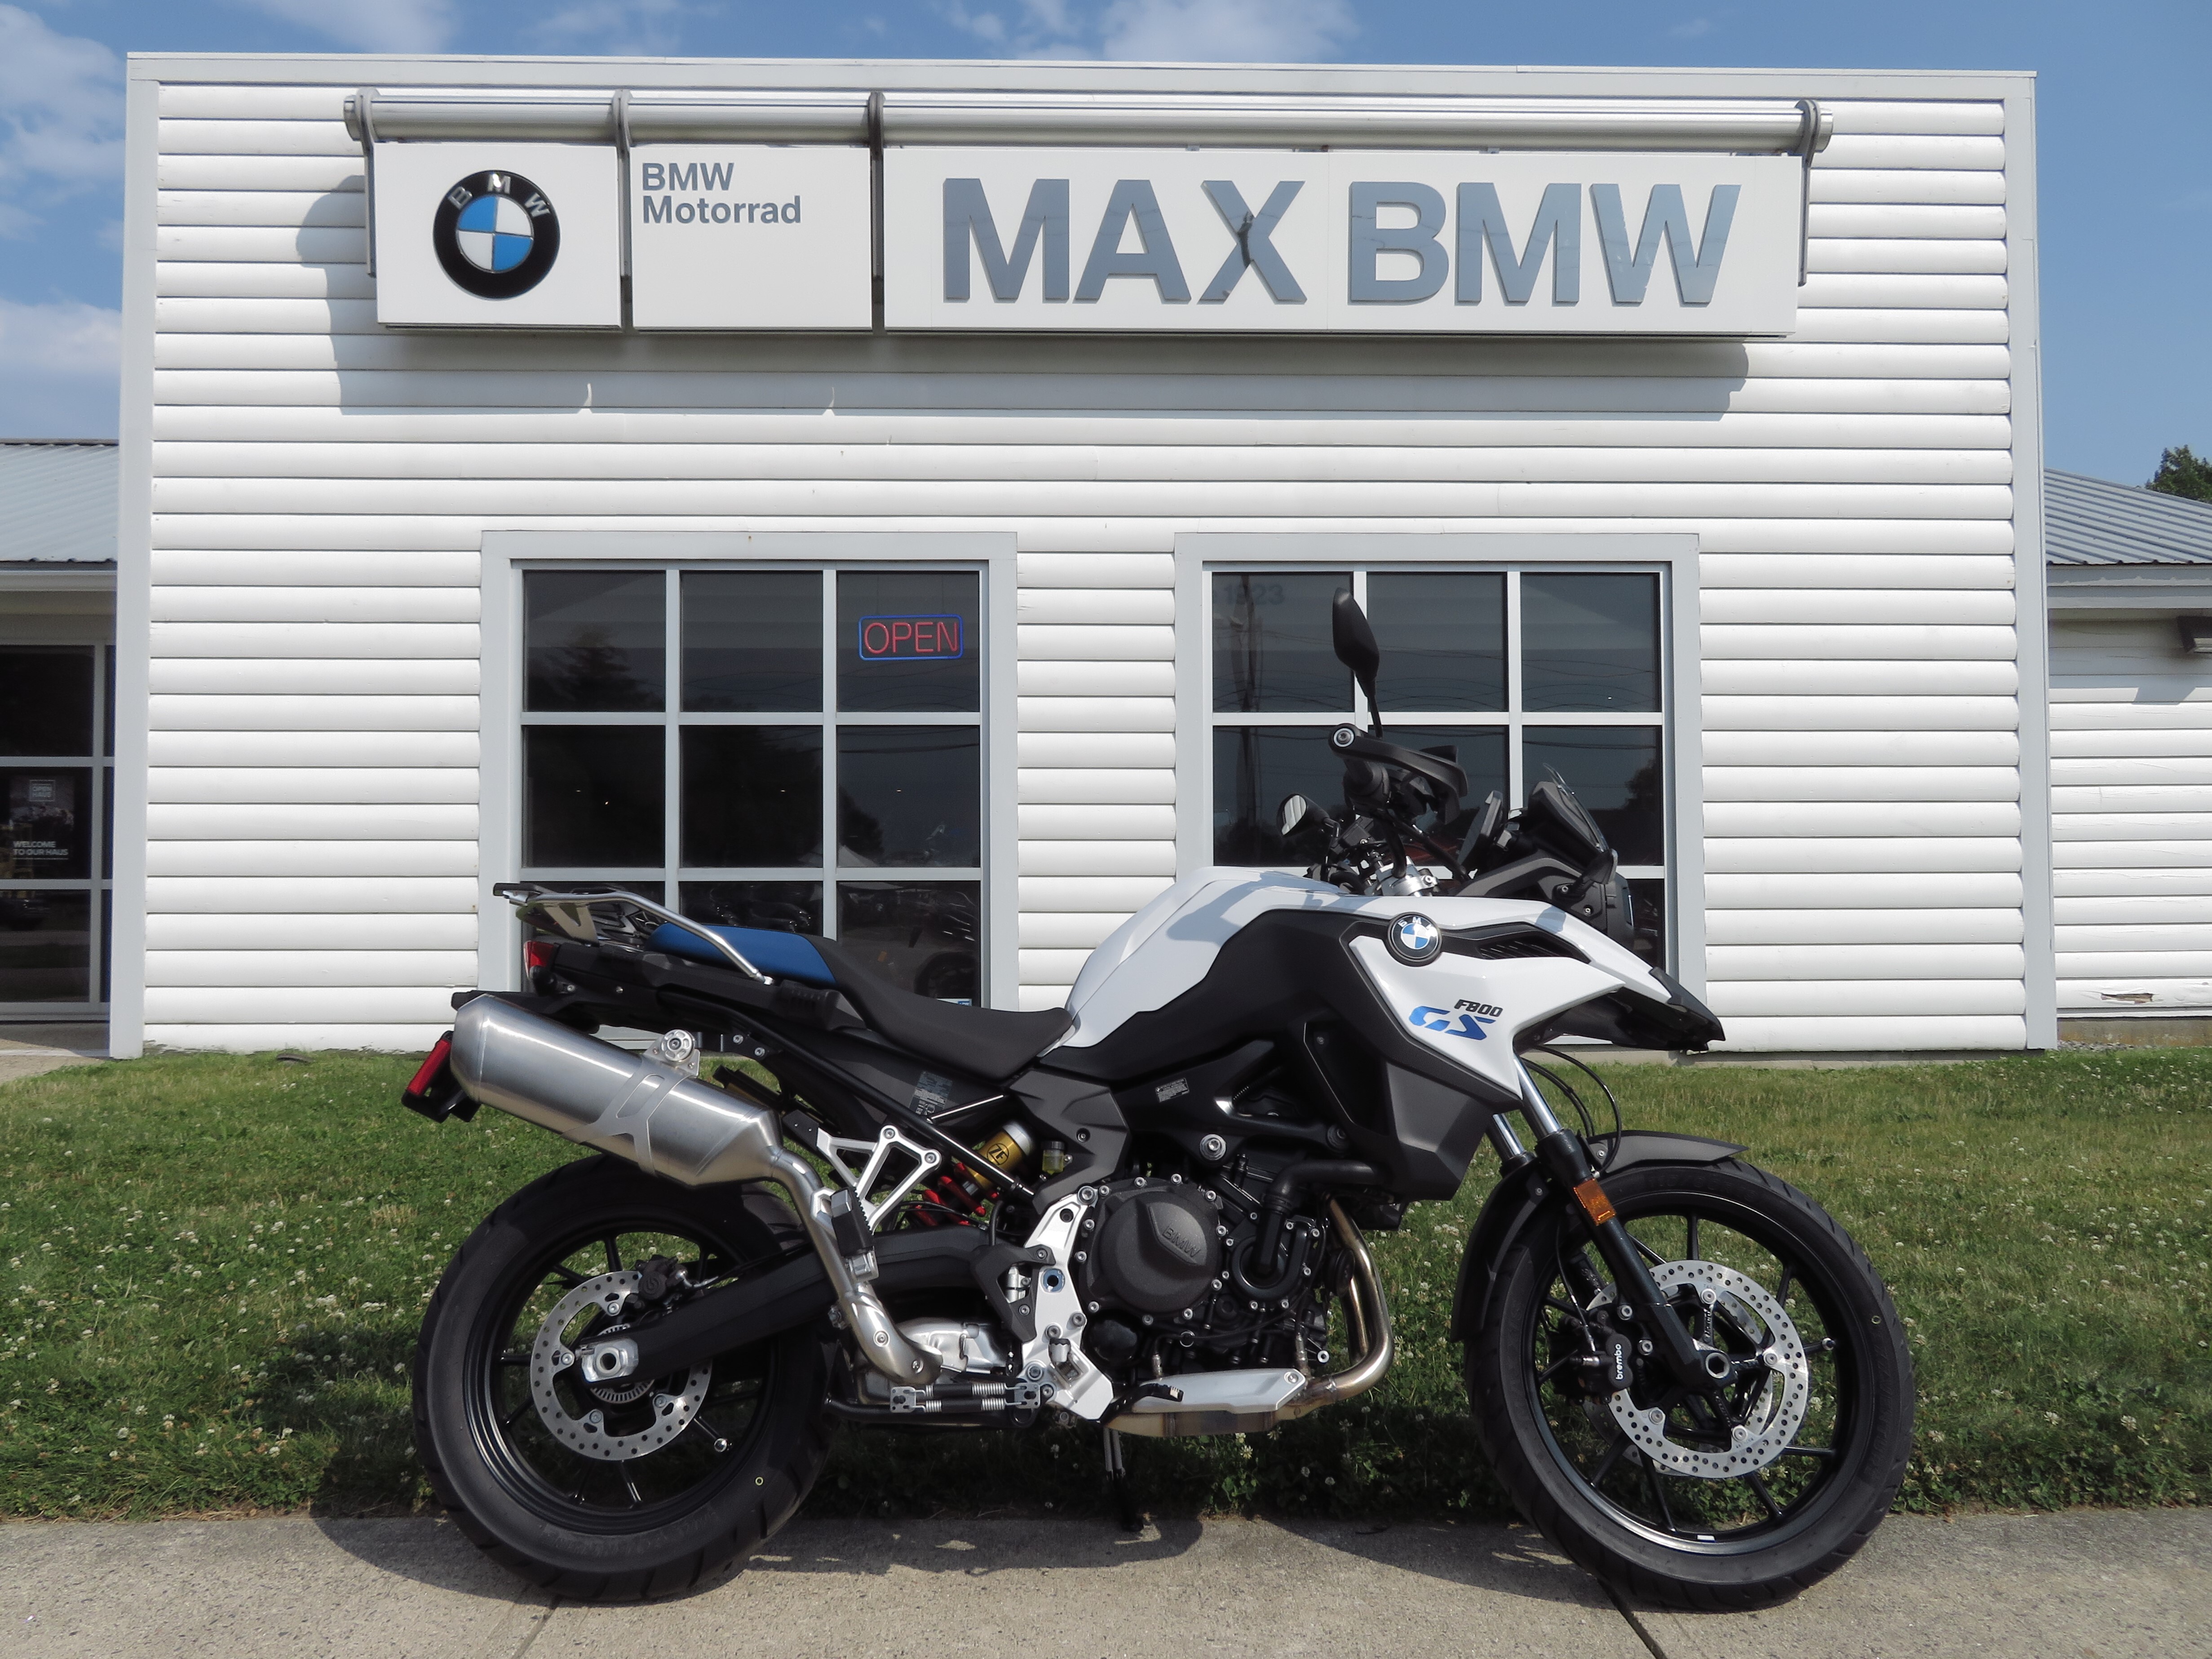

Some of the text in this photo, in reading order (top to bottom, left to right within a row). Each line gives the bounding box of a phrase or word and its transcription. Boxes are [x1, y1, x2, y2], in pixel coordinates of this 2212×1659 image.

[642, 162, 734, 191] BMW
[448, 173, 551, 217] BMW
[643, 195, 801, 224] Motorrad
[943, 178, 1742, 307] MAX BMW
[864, 622, 958, 654] OPEN
[1409, 1006, 1496, 1040] GS
[1454, 999, 1503, 1017] F800
[988, 1144, 1009, 1165] ZF
[1162, 1225, 1201, 1257] BMW
[1614, 1343, 1624, 1380] brembo
